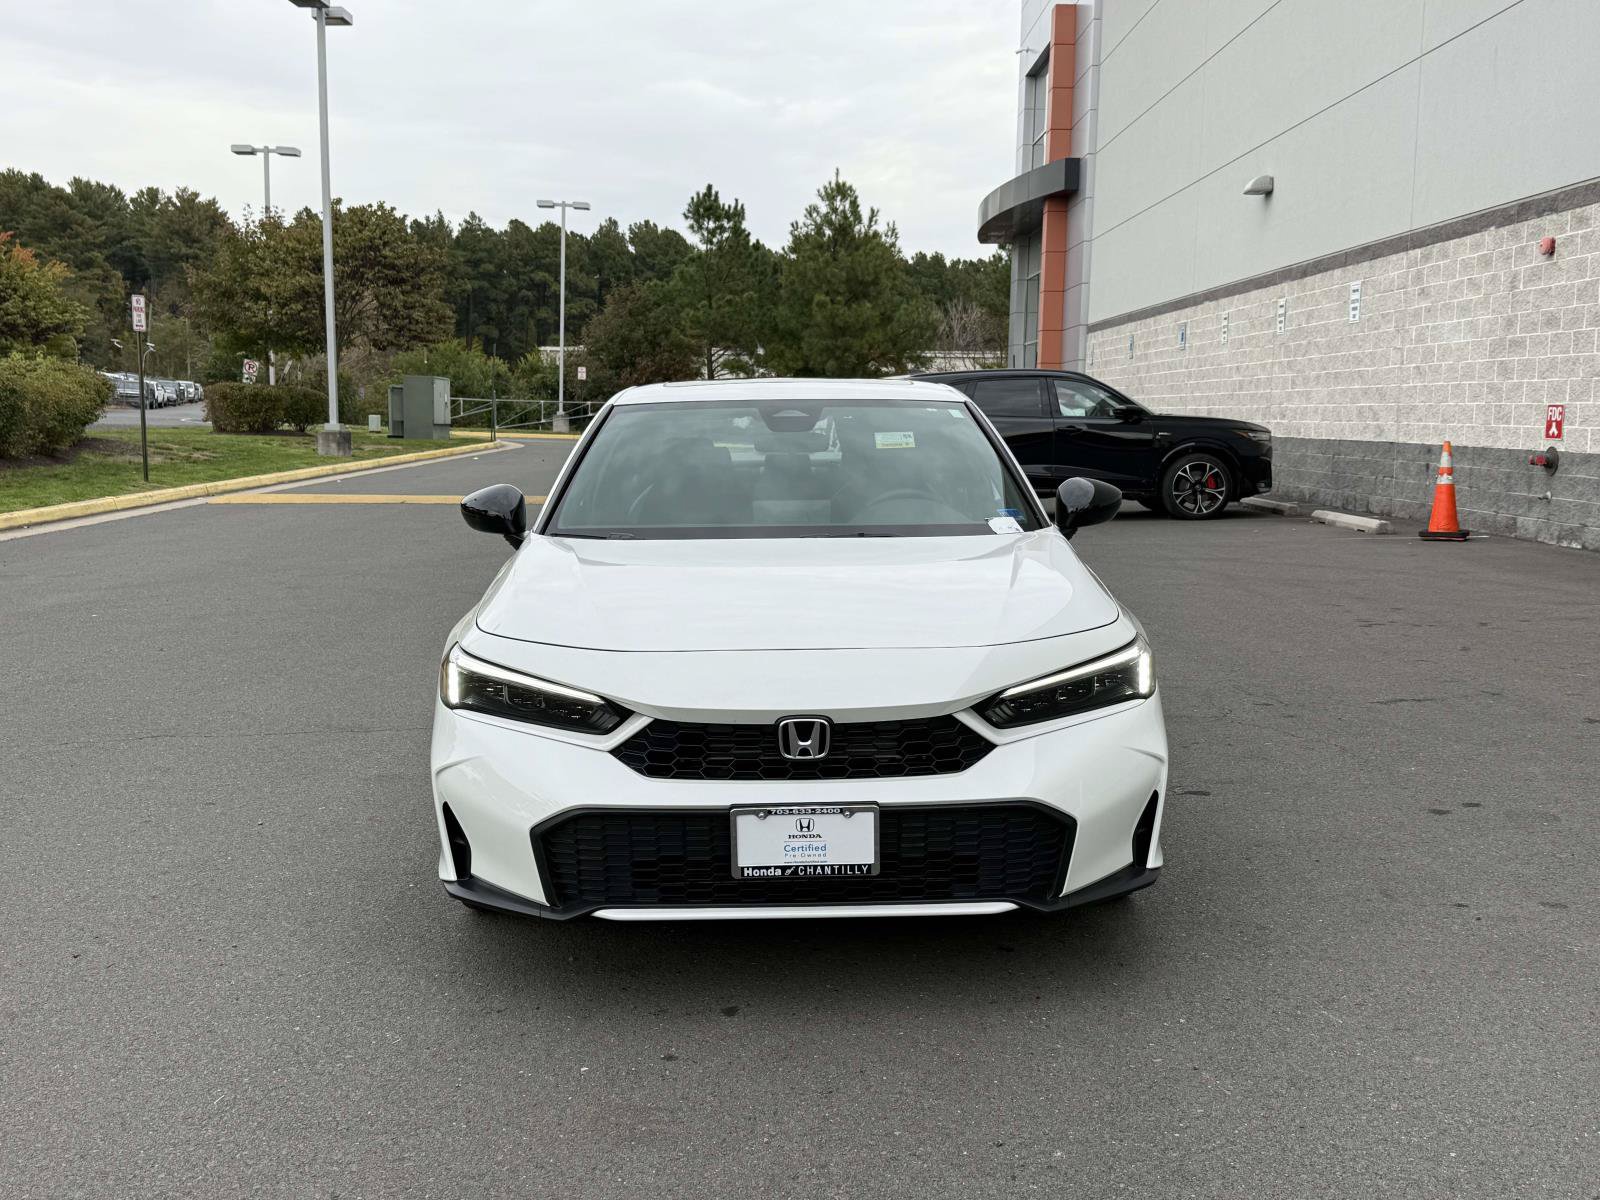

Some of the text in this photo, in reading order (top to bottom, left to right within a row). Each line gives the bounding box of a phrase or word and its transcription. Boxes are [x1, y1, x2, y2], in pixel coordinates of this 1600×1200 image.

[1547, 406, 1562, 421] FDC
[783, 843, 827, 853] Certified
[743, 867, 782, 877] Honda
[798, 864, 869, 876] CHANTILLY
